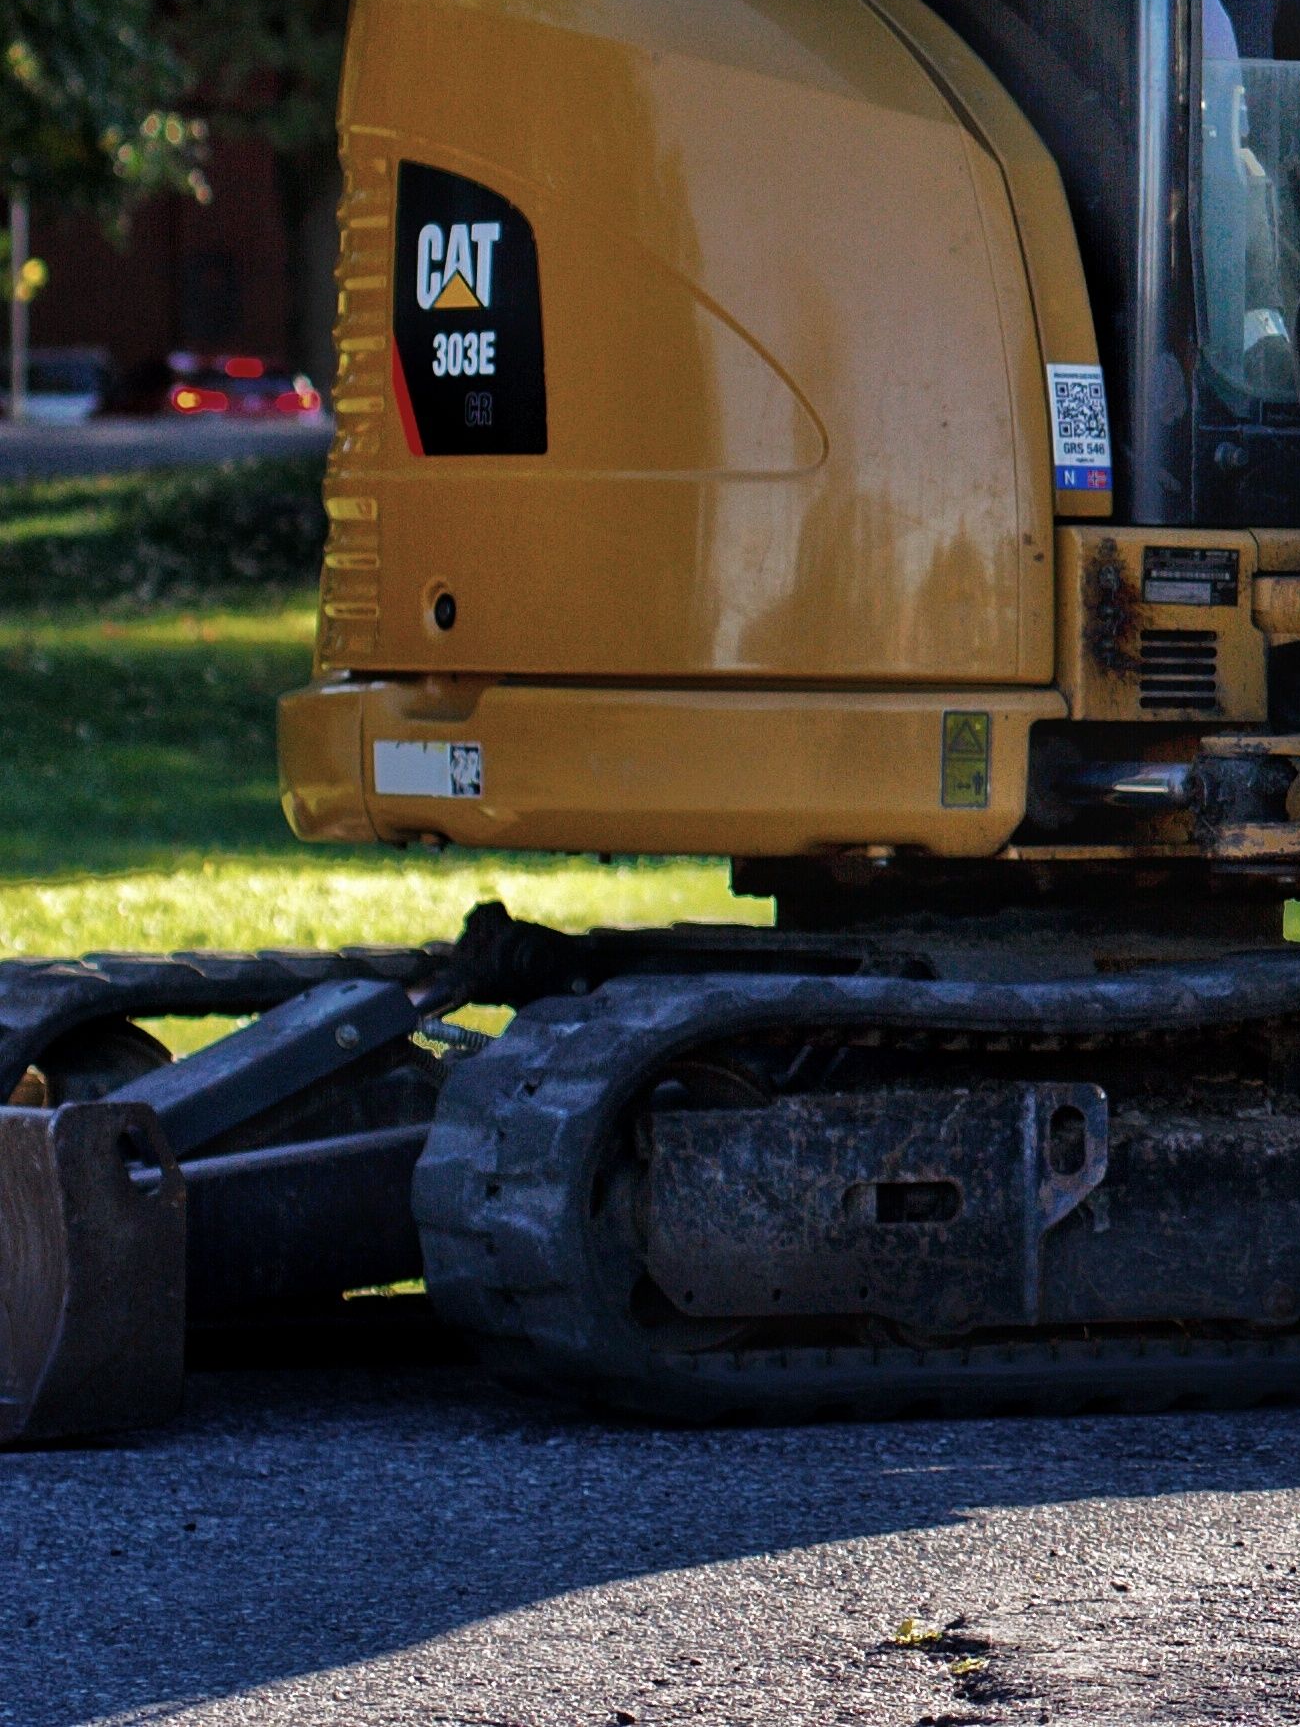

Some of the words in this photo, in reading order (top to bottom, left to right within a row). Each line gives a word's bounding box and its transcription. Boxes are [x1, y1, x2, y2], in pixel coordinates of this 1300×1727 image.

[416, 222, 501, 310] CAT
[432, 331, 496, 377] 303E
[465, 391, 493, 426] CR
[1063, 442, 1085, 454] GRS
[1064, 470, 1075, 485] N
